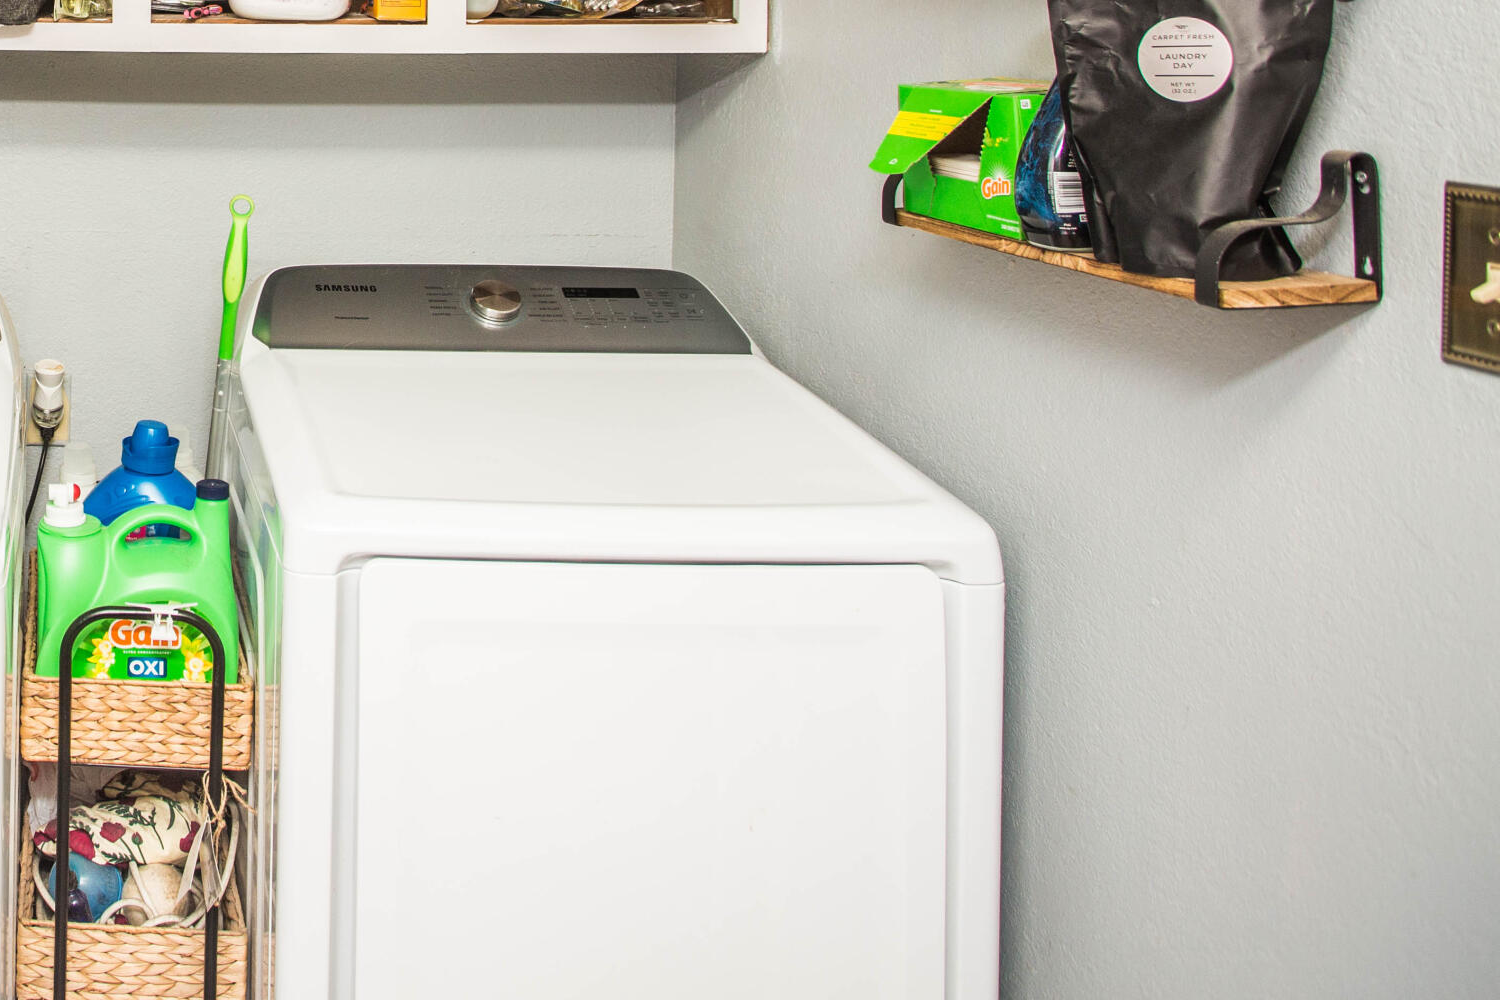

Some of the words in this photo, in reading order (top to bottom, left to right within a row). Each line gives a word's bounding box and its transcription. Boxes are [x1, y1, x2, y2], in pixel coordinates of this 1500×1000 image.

[981, 177, 1011, 199] Gain
[315, 284, 377, 293] SAMSUNG
[110, 618, 180, 647] Ga
[129, 660, 165, 676] OXI
